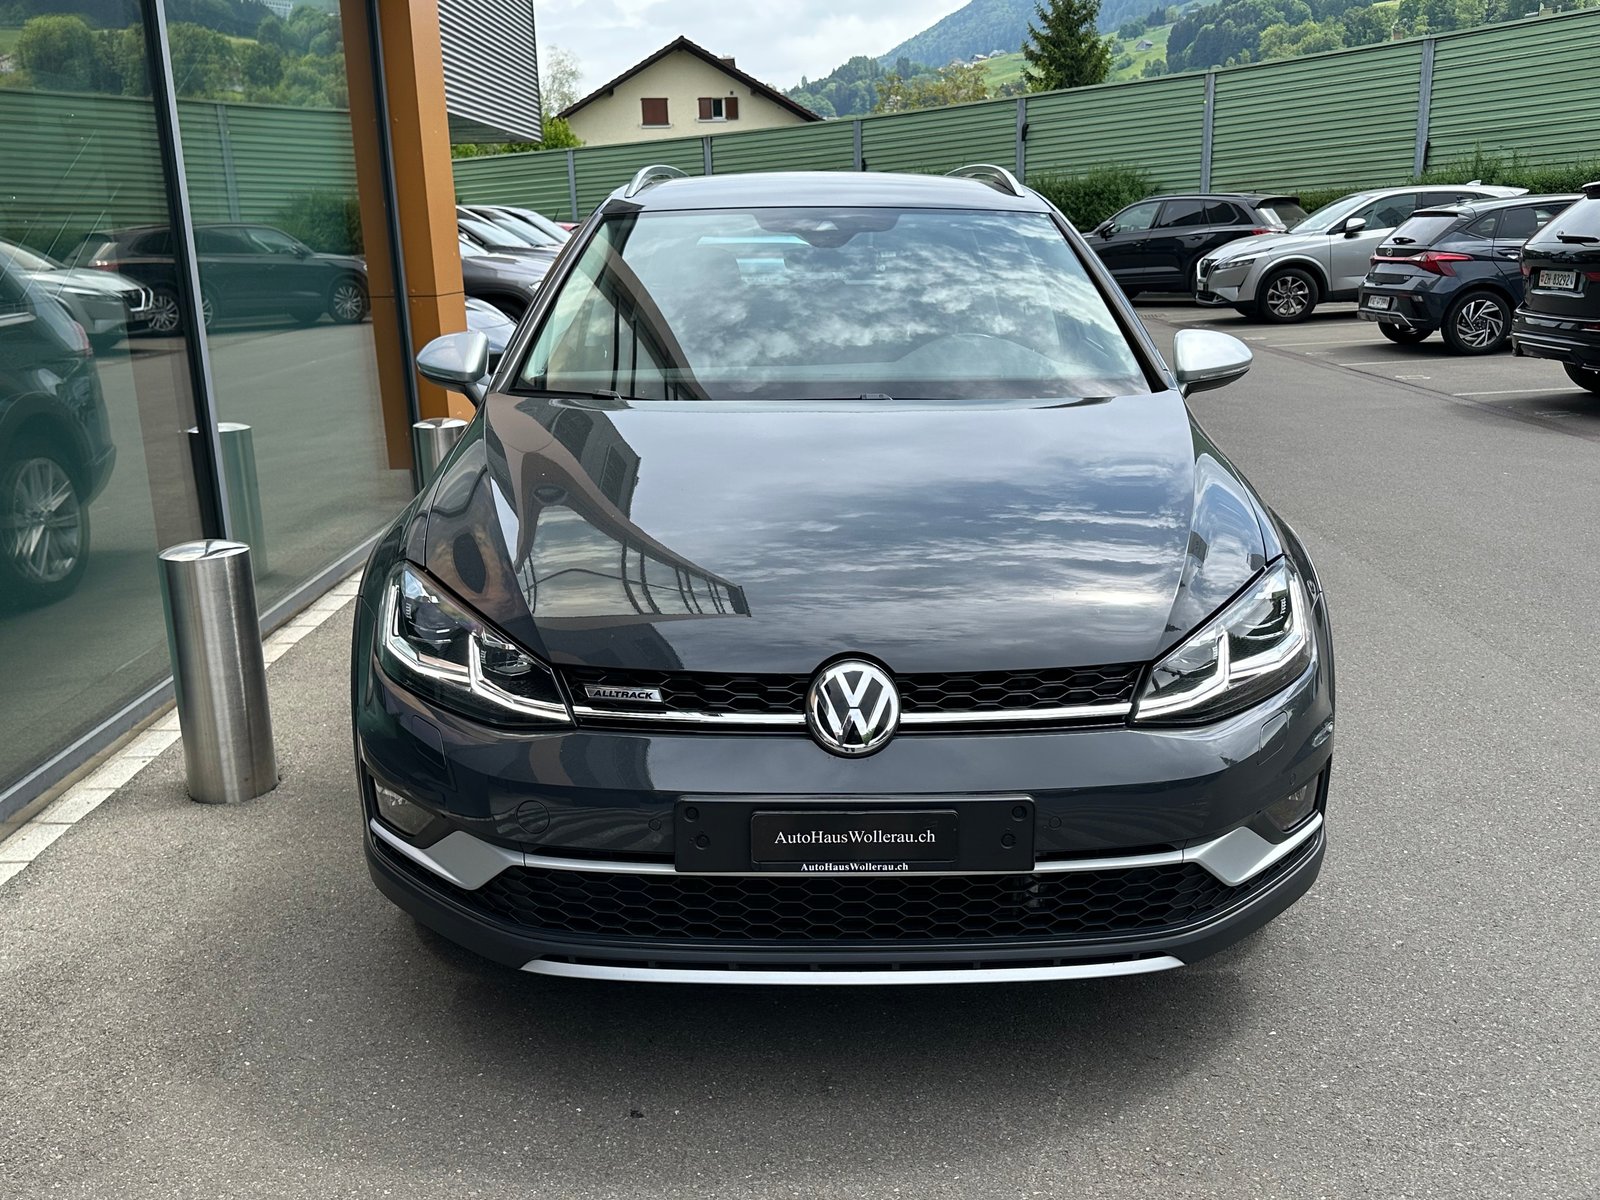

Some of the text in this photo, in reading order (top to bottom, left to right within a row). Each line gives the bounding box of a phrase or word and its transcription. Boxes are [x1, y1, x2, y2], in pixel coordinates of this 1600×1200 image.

[593, 690, 654, 700] ALLTRACK
[811, 661, 896, 749] VW
[774, 830, 936, 845] AutoHausWollerau.ch
[800, 862, 909, 872] AutoHausWollerau.ch
